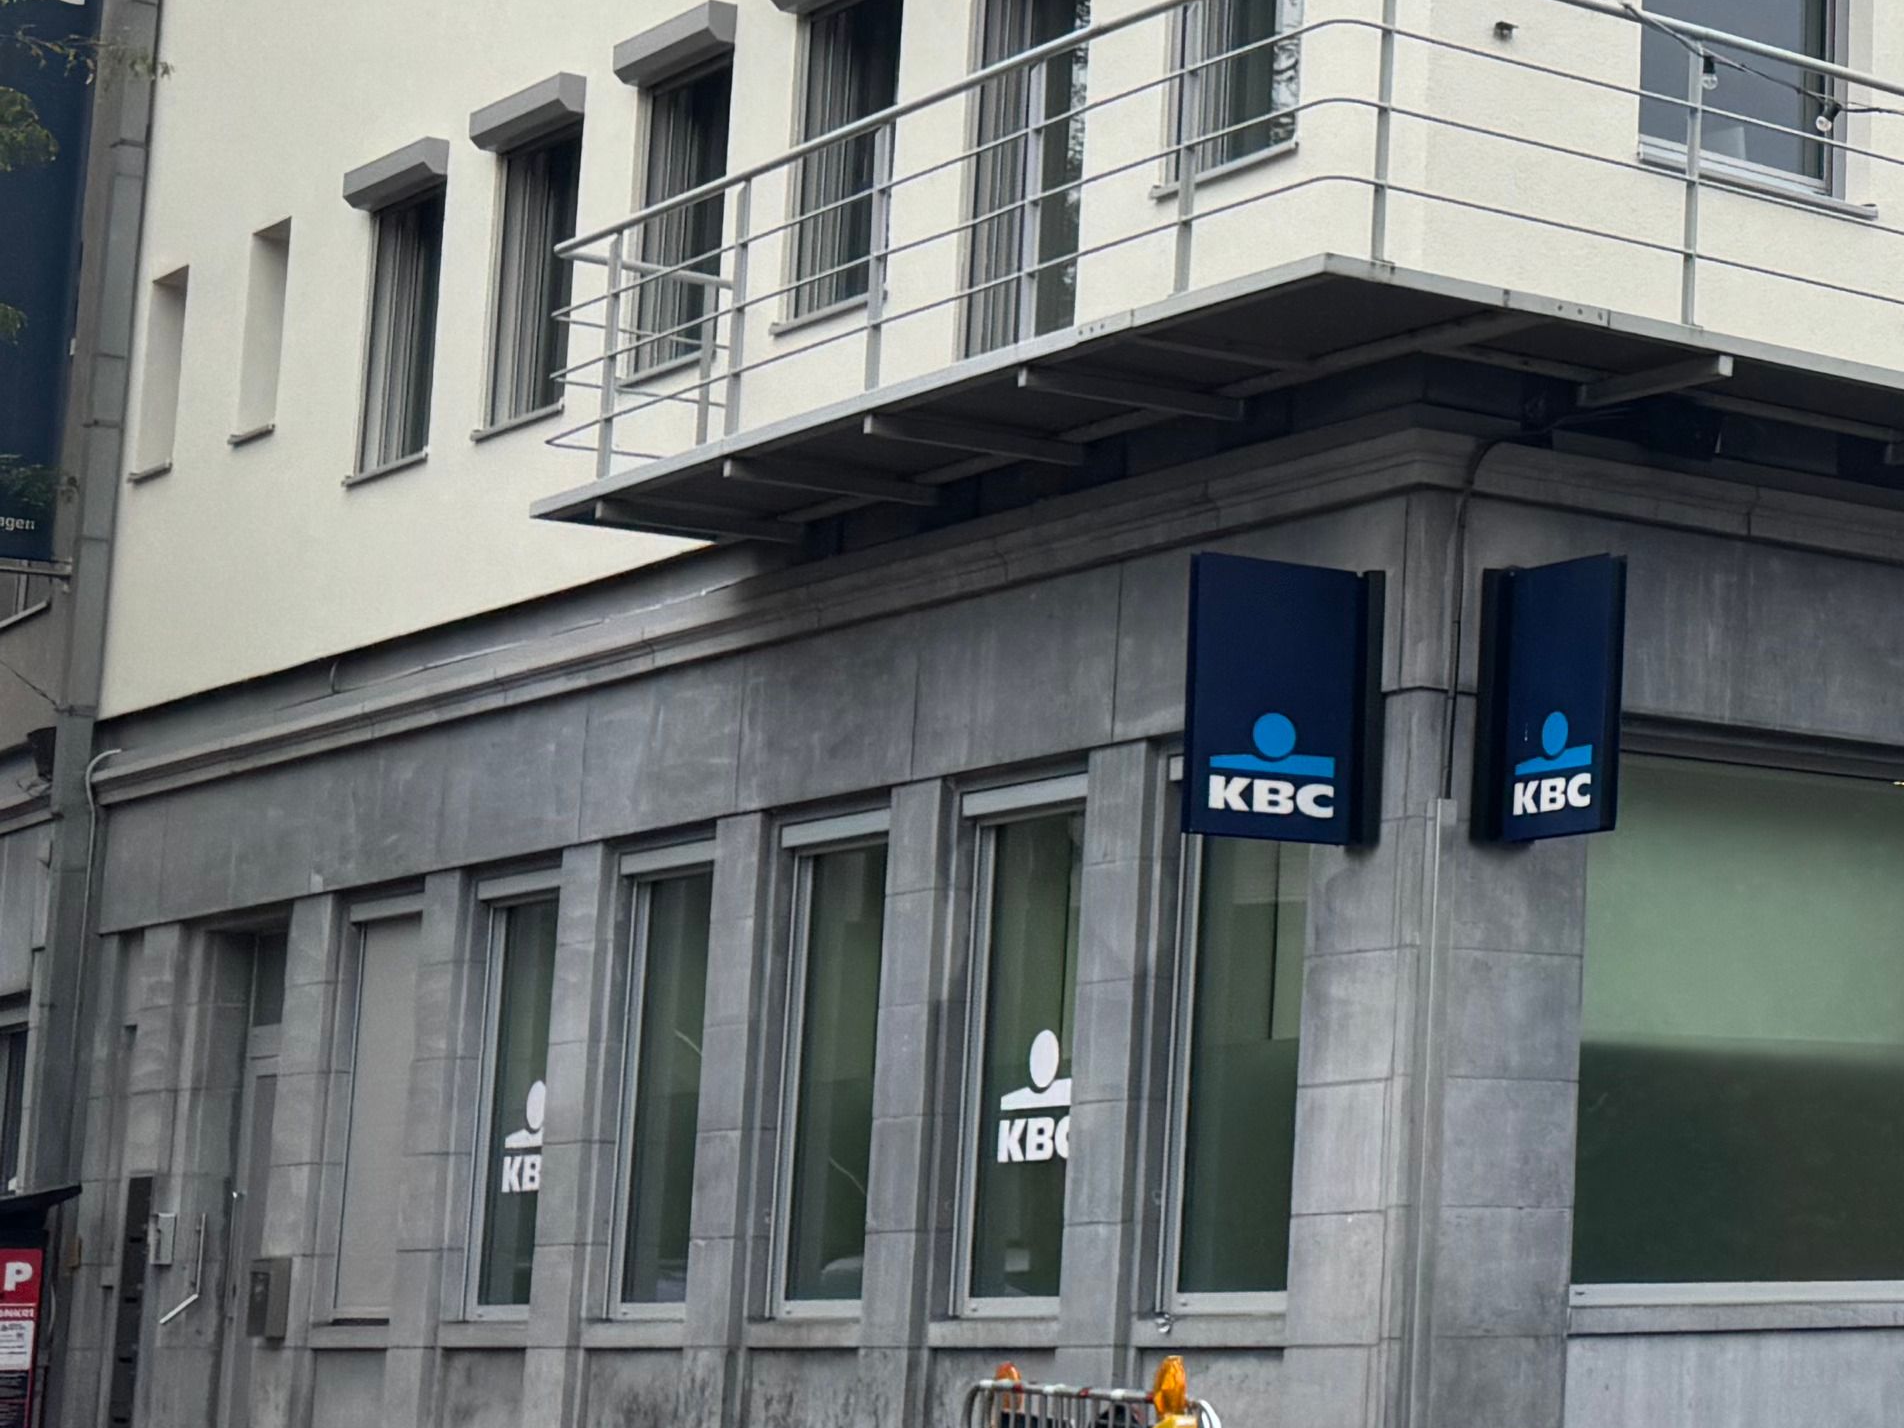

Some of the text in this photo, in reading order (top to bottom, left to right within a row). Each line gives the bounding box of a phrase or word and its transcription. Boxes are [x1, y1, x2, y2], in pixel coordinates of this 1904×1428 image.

[1208, 775, 1334, 818] KBC
[1512, 773, 1592, 816] KBC
[501, 1154, 543, 1193] KB
[3, 1261, 33, 1292] P
